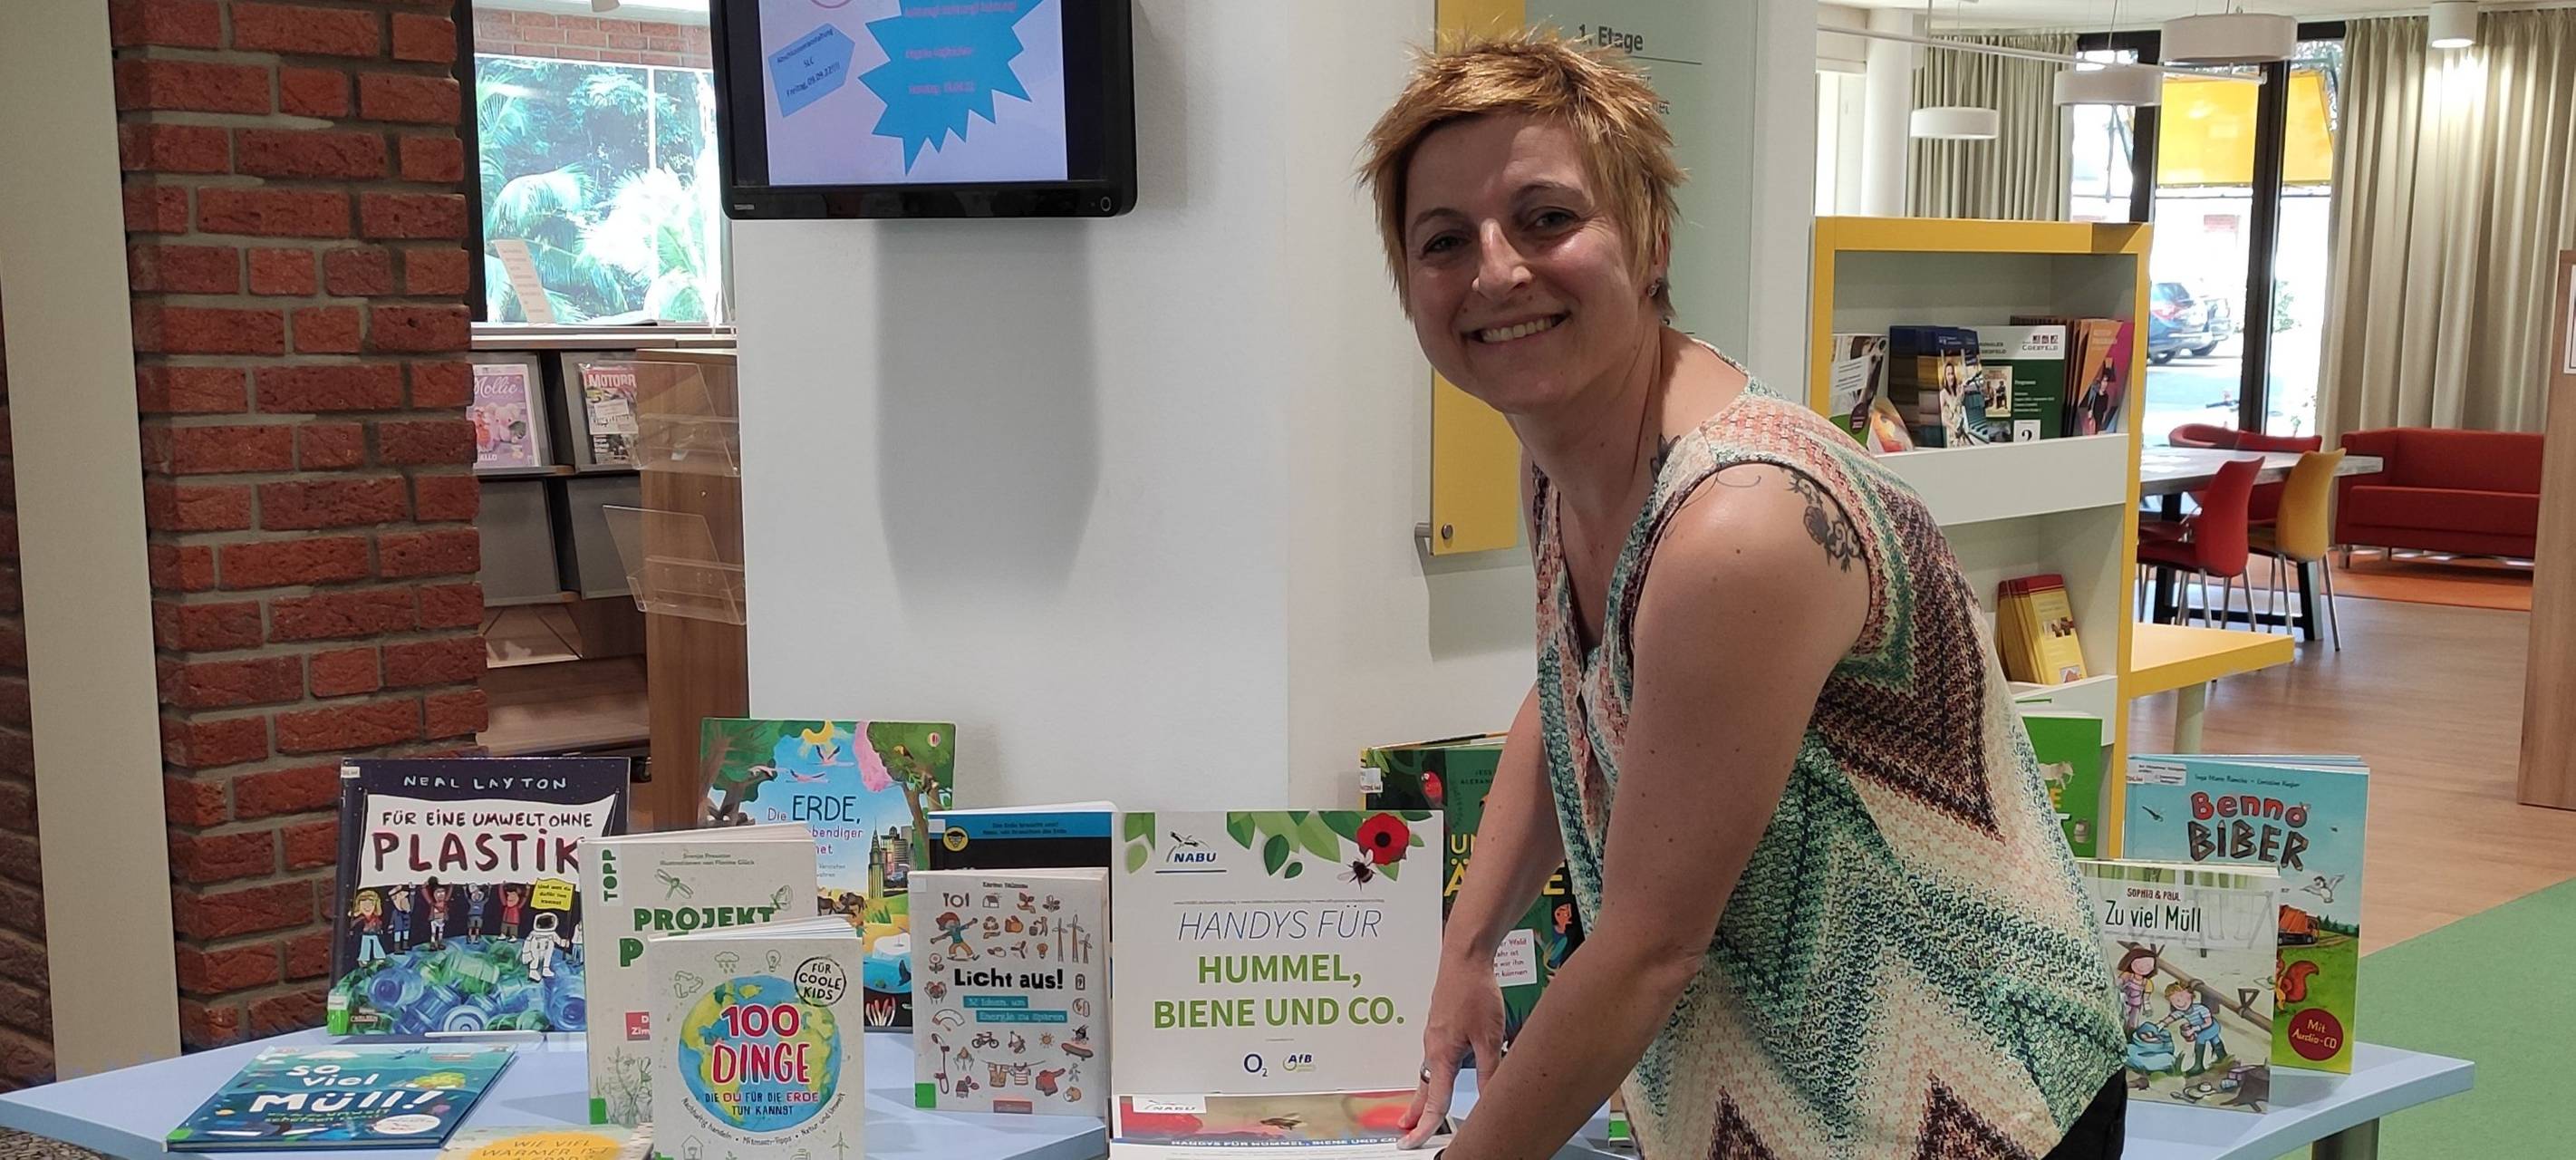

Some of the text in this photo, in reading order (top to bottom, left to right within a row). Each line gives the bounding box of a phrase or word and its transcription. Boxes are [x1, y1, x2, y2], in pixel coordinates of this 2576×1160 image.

[1597, 25, 1644, 53] Etage
[403, 775, 567, 789] NEAL LAYTON
[381, 811, 417, 826] FÜR
[473, 812, 543, 827] UMWELT
[549, 814, 593, 828] OHNE
[767, 795, 861, 824] Die ERDE,
[2190, 790, 2309, 829] Benno
[371, 828, 581, 875] PLASTIK
[2187, 819, 2309, 872] BIBER
[1174, 852, 1216, 863] NABU
[602, 848, 619, 902] TOPP
[2126, 887, 2181, 902] SOPHIA & PAUL
[633, 906, 776, 932] PROJEKT
[1178, 904, 1382, 941] HANDYS FÜR
[2105, 900, 2202, 933] Zu viel Müll
[812, 962, 832, 974] FÜR
[954, 967, 1064, 990] Licht aus!
[1198, 954, 1362, 988] HUMMEL,
[798, 972, 843, 991] COOLE
[803, 986, 834, 1000] KIDS
[720, 1003, 802, 1039] 100
[1153, 997, 1404, 1029] BIENE UND CO.
[2307, 1018, 2327, 1033] Mit
[2291, 1030, 2338, 1049] Audio-CD
[711, 1041, 812, 1086] DINGE
[1288, 1053, 1312, 1064] AfB
[248, 1090, 444, 1113] Müll!
[705, 1091, 820, 1103] DIE DU FÜR DIE ERDE
[731, 1105, 794, 1116] TUN KANNST
